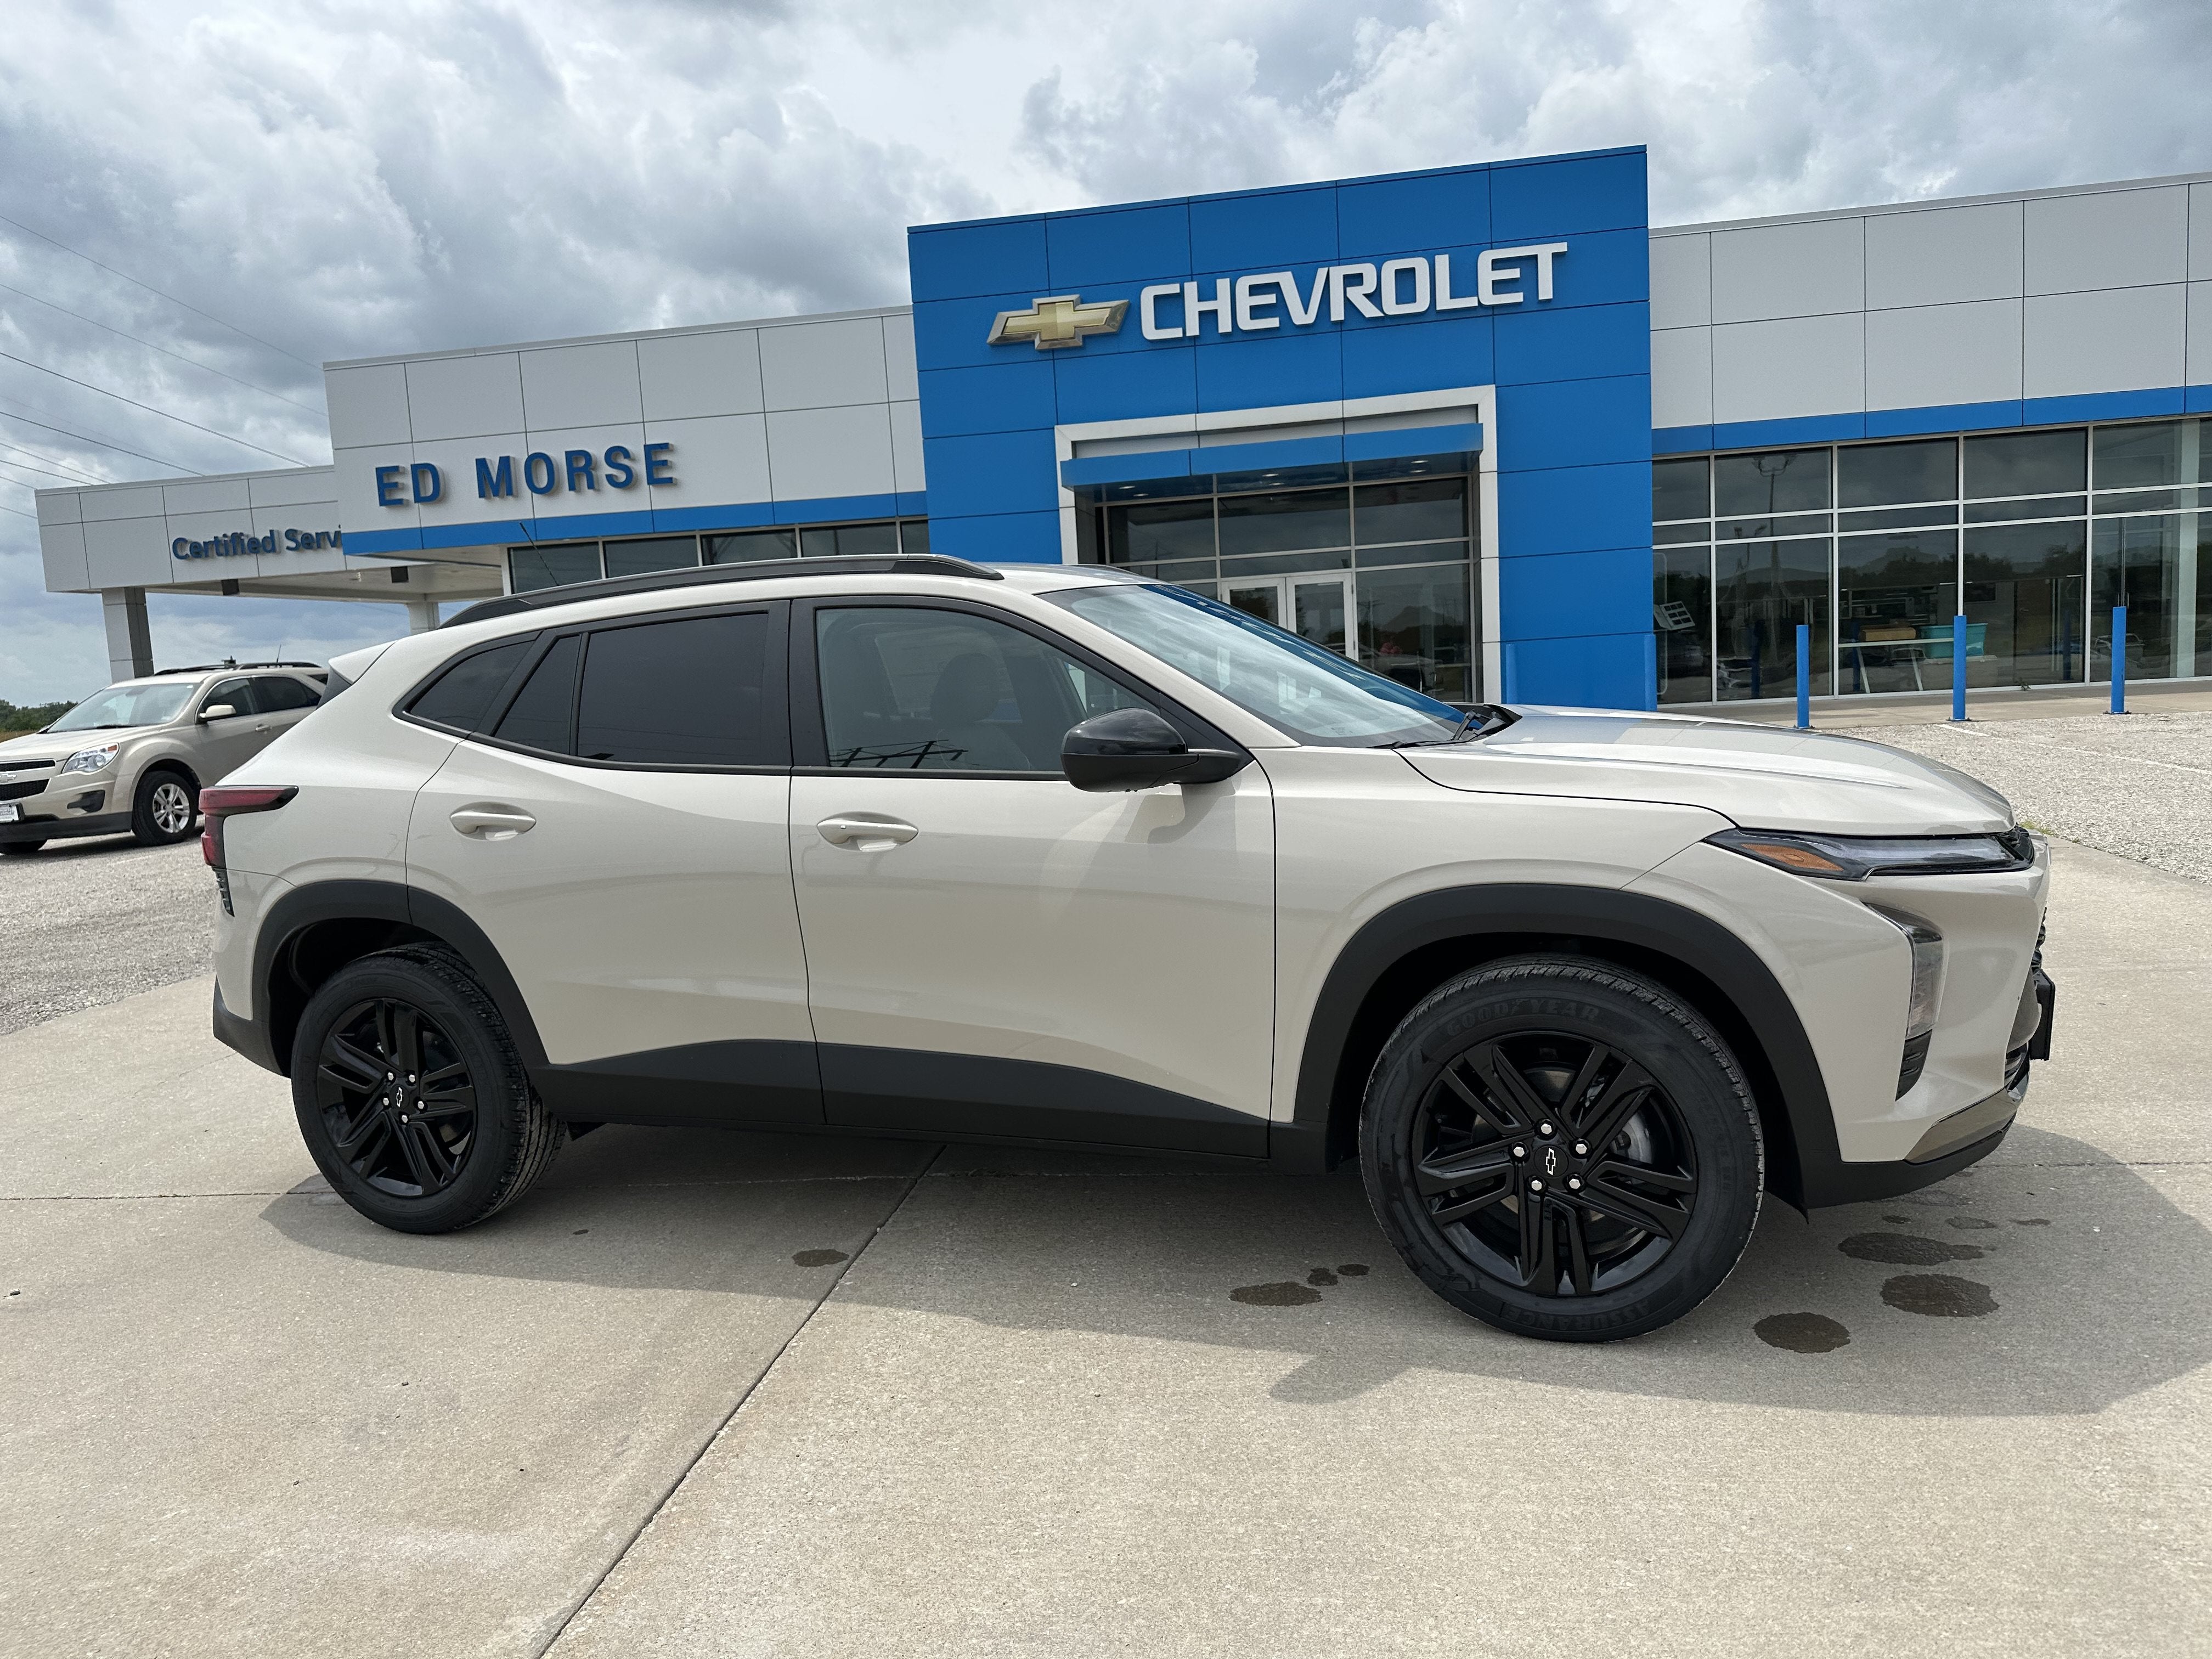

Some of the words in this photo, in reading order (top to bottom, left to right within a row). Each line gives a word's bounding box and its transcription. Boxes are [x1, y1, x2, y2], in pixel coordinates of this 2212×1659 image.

[1140, 242, 1567, 340] CHEVROLET
[375, 462, 441, 507] ED
[475, 442, 674, 498] MORSE
[172, 529, 277, 560] Certified
